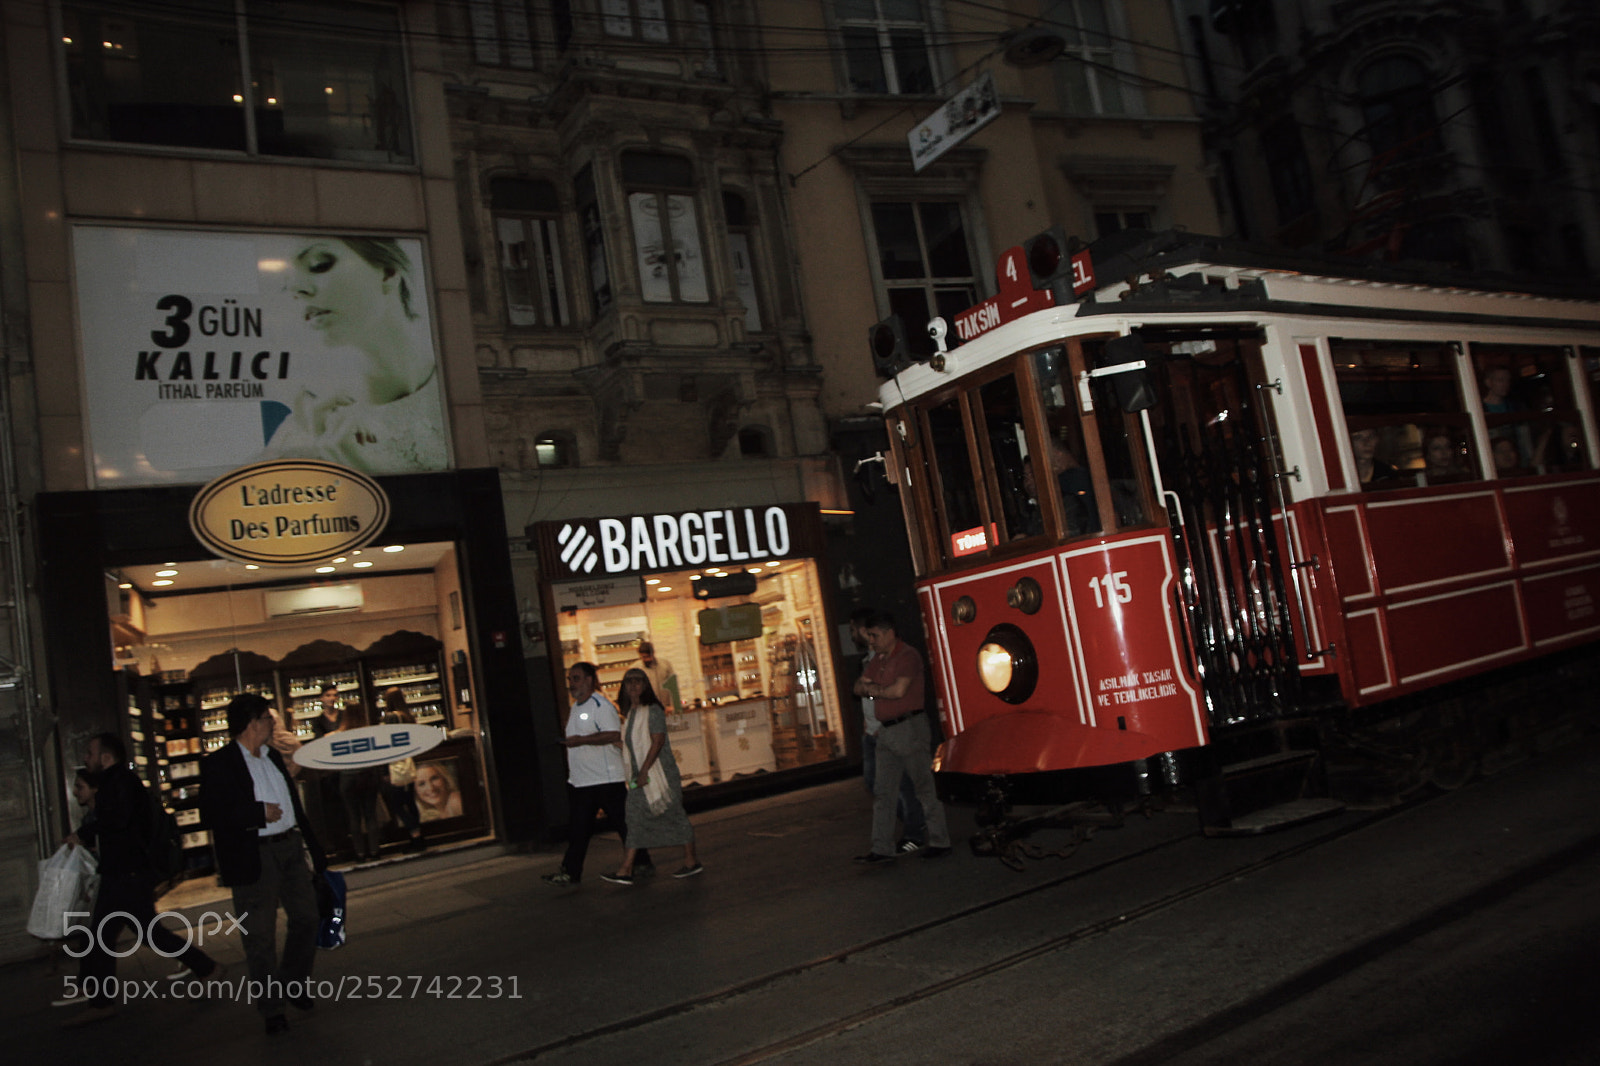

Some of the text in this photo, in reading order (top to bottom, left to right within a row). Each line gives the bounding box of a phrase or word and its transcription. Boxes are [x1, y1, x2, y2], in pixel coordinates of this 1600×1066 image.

[1005, 255, 1018, 282] 4
[151, 294, 262, 349] 3 GÜN
[954, 301, 1001, 341] TAKSİM
[134, 351, 290, 381] KALICI
[205, 378, 264, 399] PARFÜM
[241, 482, 337, 508] L'adresse
[229, 512, 362, 541] Des Parfums
[598, 506, 791, 573] BARGELLO
[1088, 570, 1132, 608] 115
[1142, 668, 1173, 685] YASAK
[1097, 693, 1111, 707] VE
